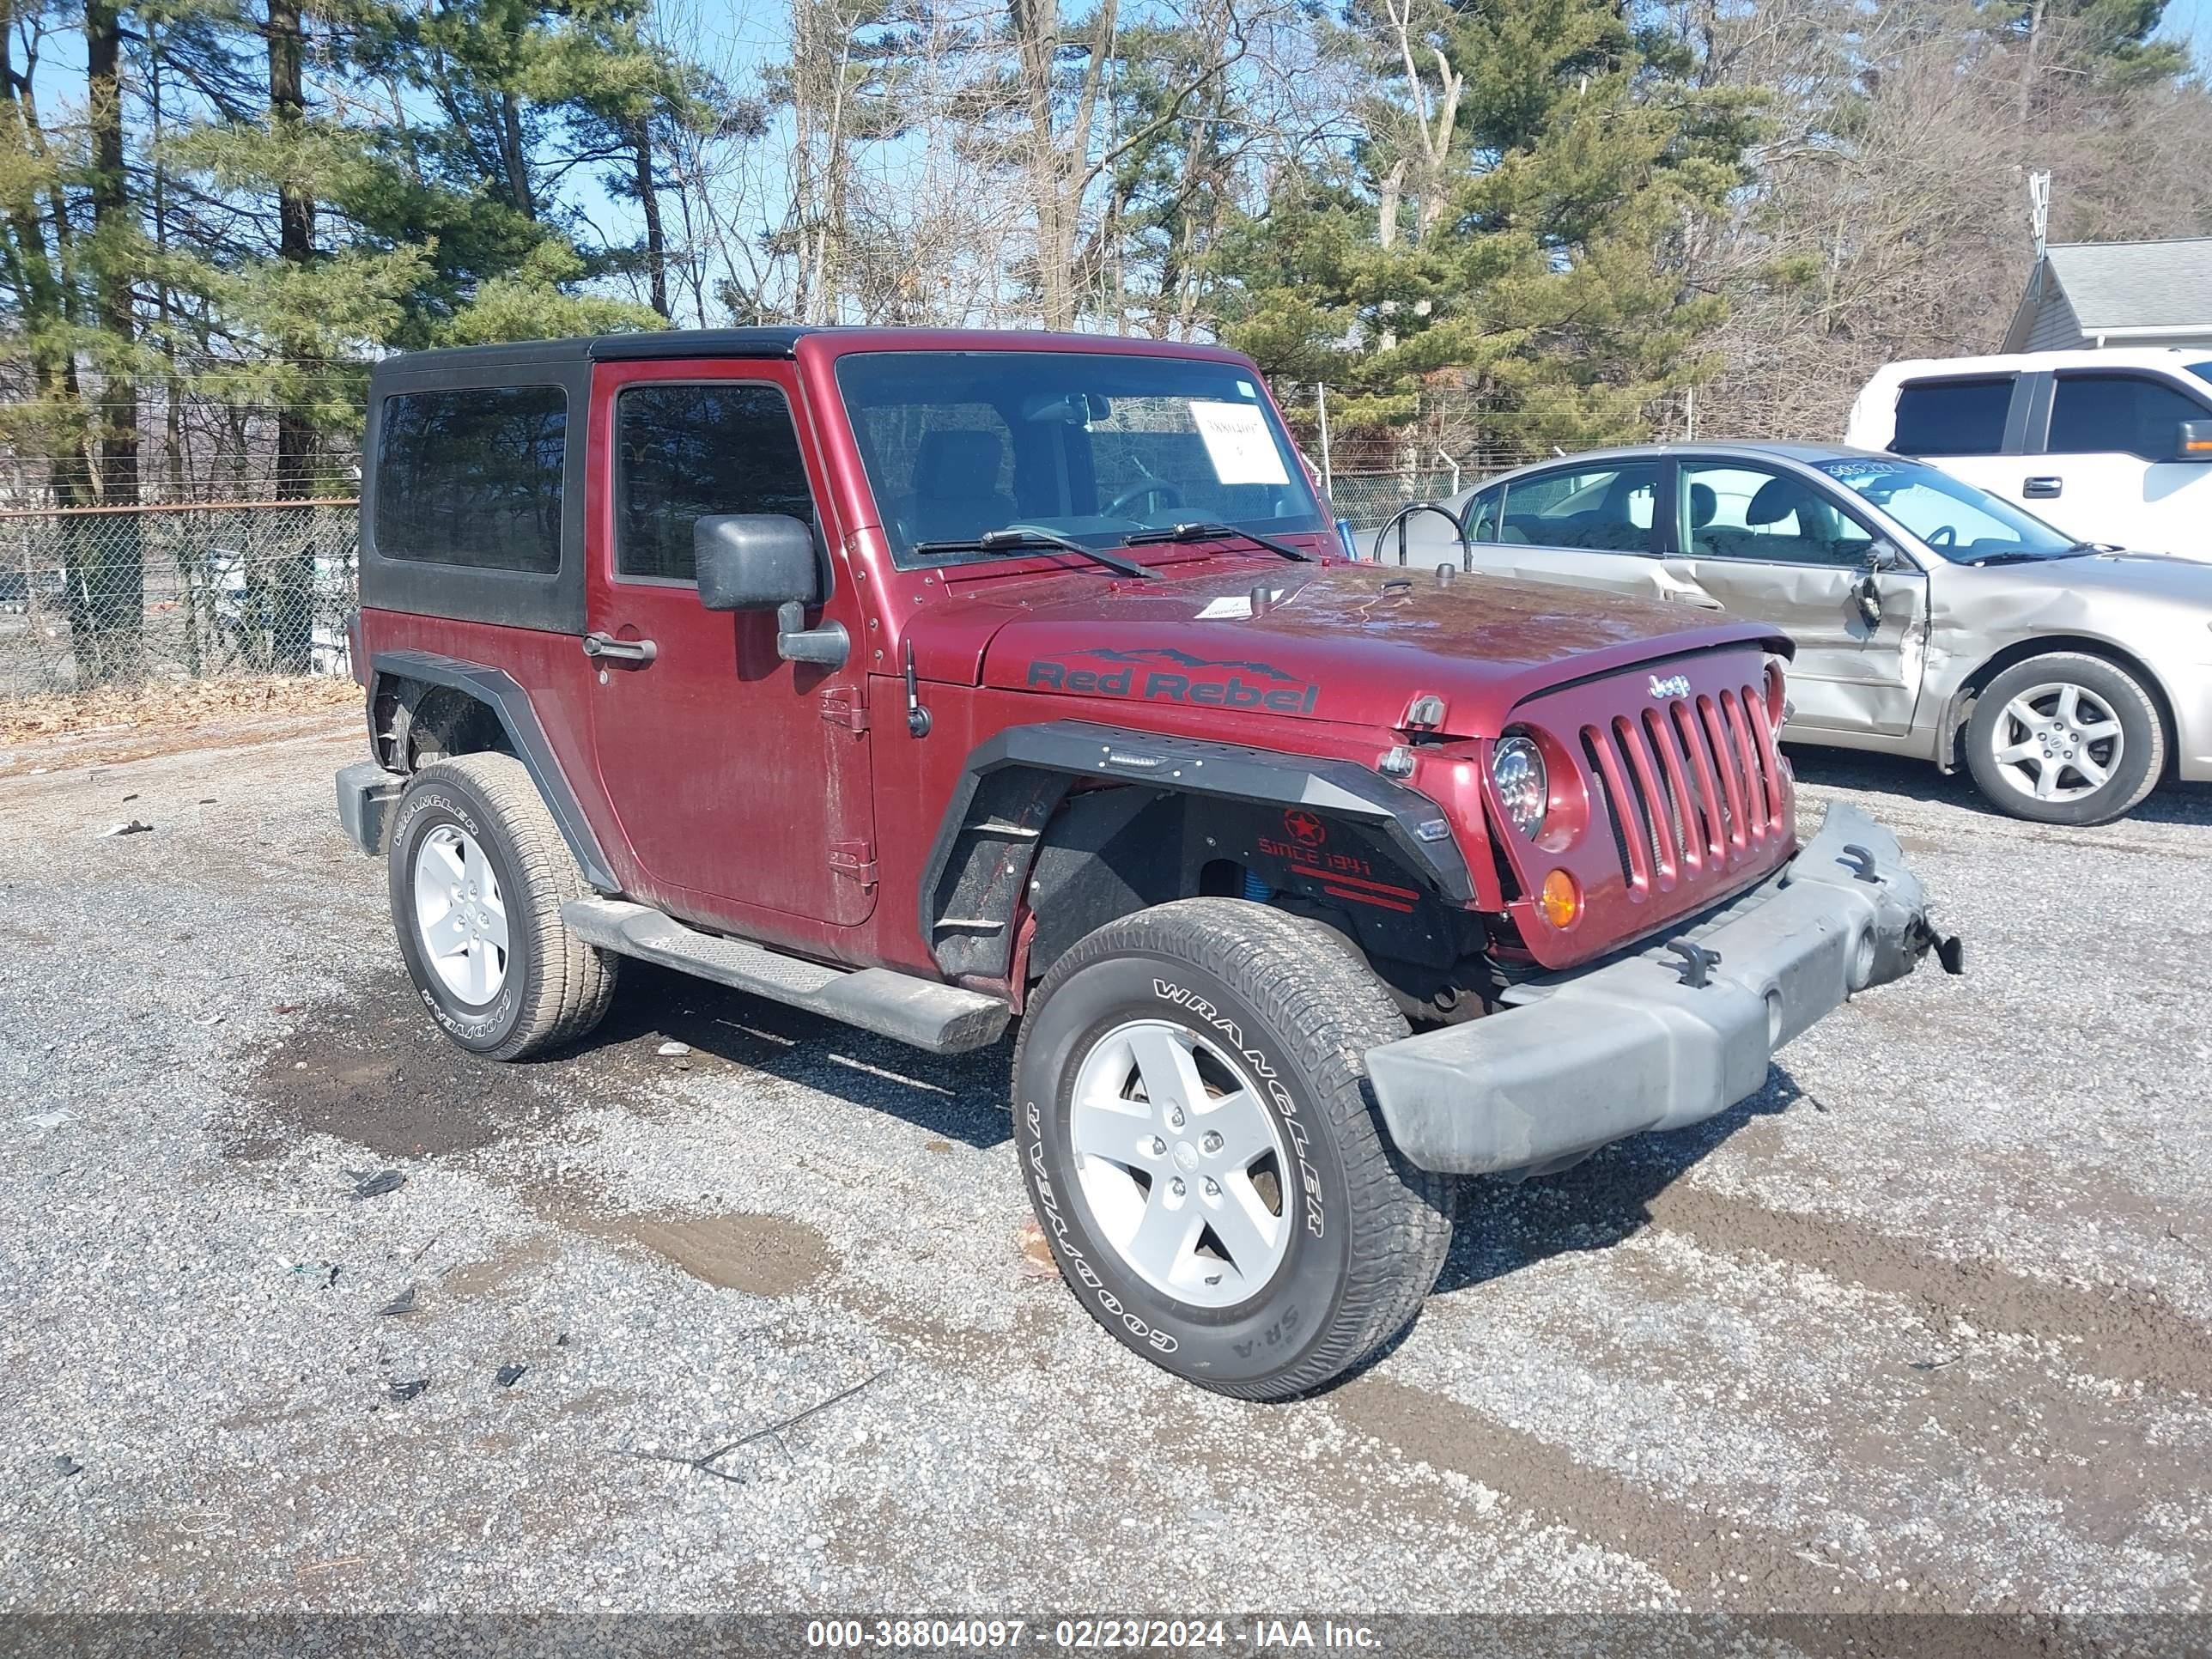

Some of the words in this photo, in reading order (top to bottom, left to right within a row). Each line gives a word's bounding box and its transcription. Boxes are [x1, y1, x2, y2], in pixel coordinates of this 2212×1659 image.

[1027, 660, 1135, 696] Red
[1145, 672, 1321, 715] Rebel
[1648, 674, 1691, 699] Jeep
[393, 794, 479, 847] WRANGLER
[1257, 837, 1320, 864] SINCE
[1325, 852, 1371, 876] 1941
[421, 988, 512, 1040] GOODYEAR
[1153, 977, 1324, 1238] WRANGLER
[1027, 1101, 1179, 1353] GOODYEAR
